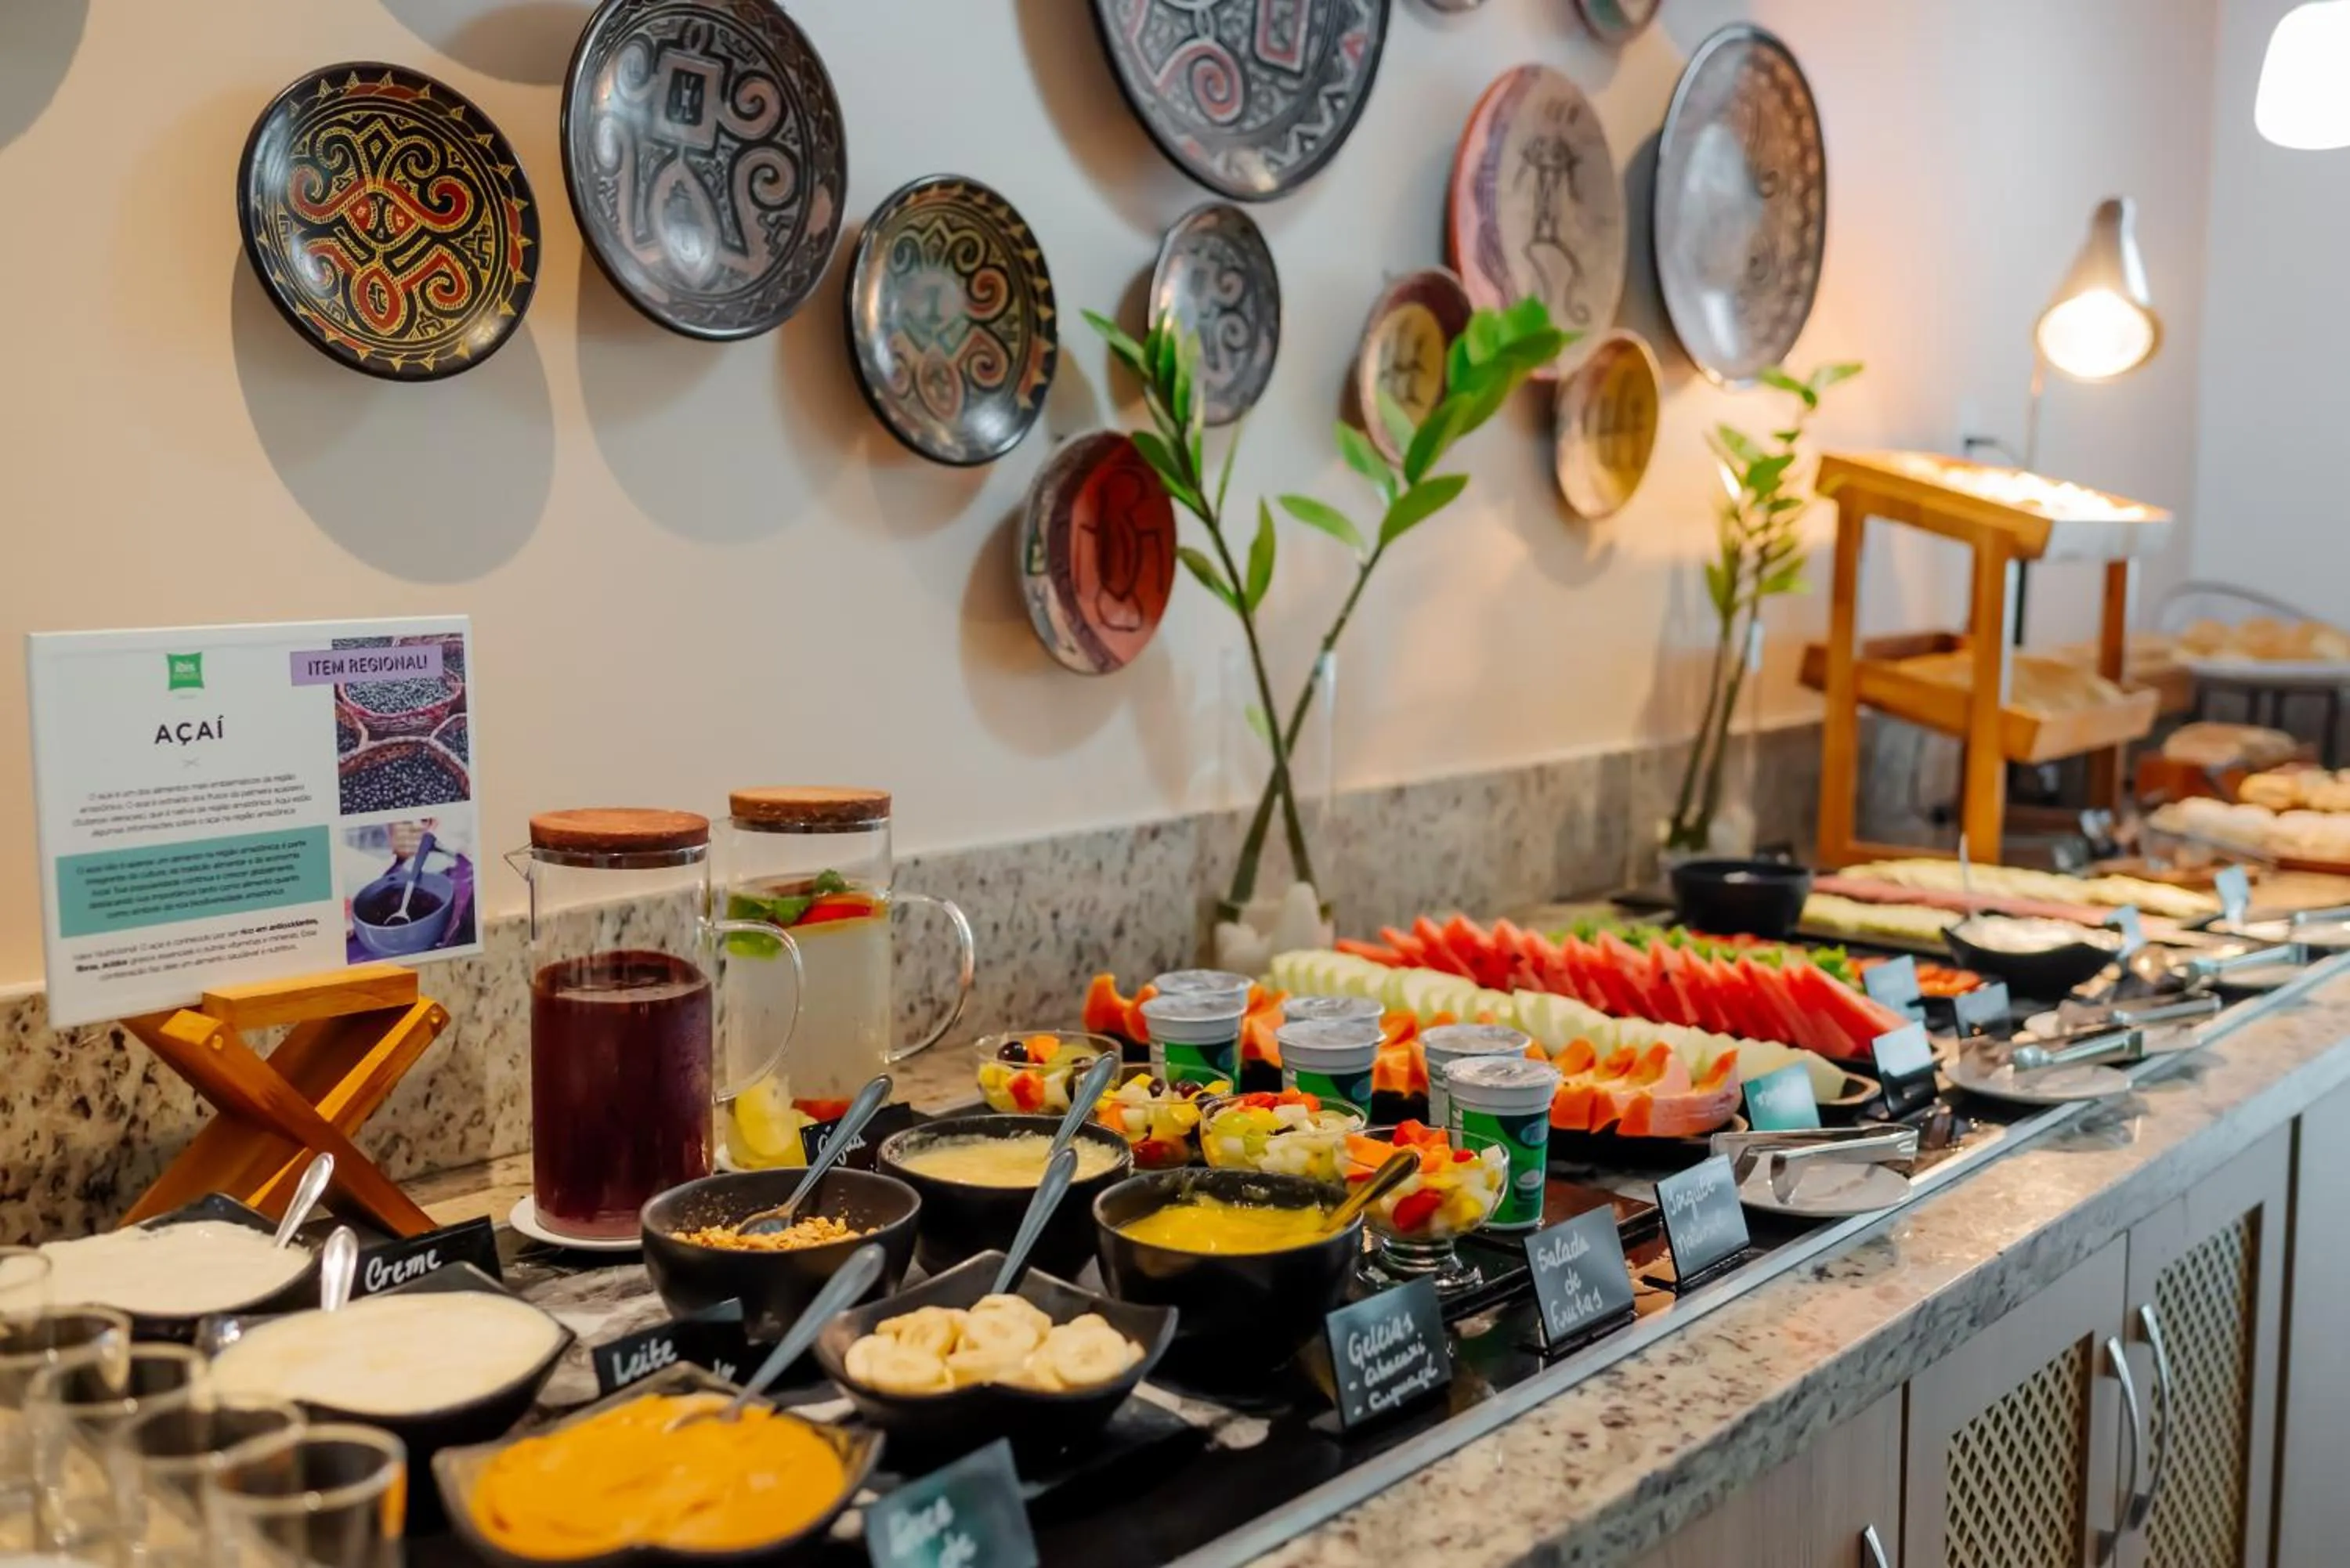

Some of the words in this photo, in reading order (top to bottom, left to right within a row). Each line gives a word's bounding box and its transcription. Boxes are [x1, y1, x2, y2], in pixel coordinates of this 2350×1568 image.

[308, 659, 345, 677] ITEM
[348, 655, 428, 674] REGIONAL!
[154, 714, 225, 746] AÇAÍ
[364, 1248, 443, 1292] Creme
[1537, 1229, 1591, 1273] Salada
[1564, 1266, 1582, 1296] de
[1549, 1284, 1603, 1332] Frutas
[612, 1337, 678, 1386] Leite
